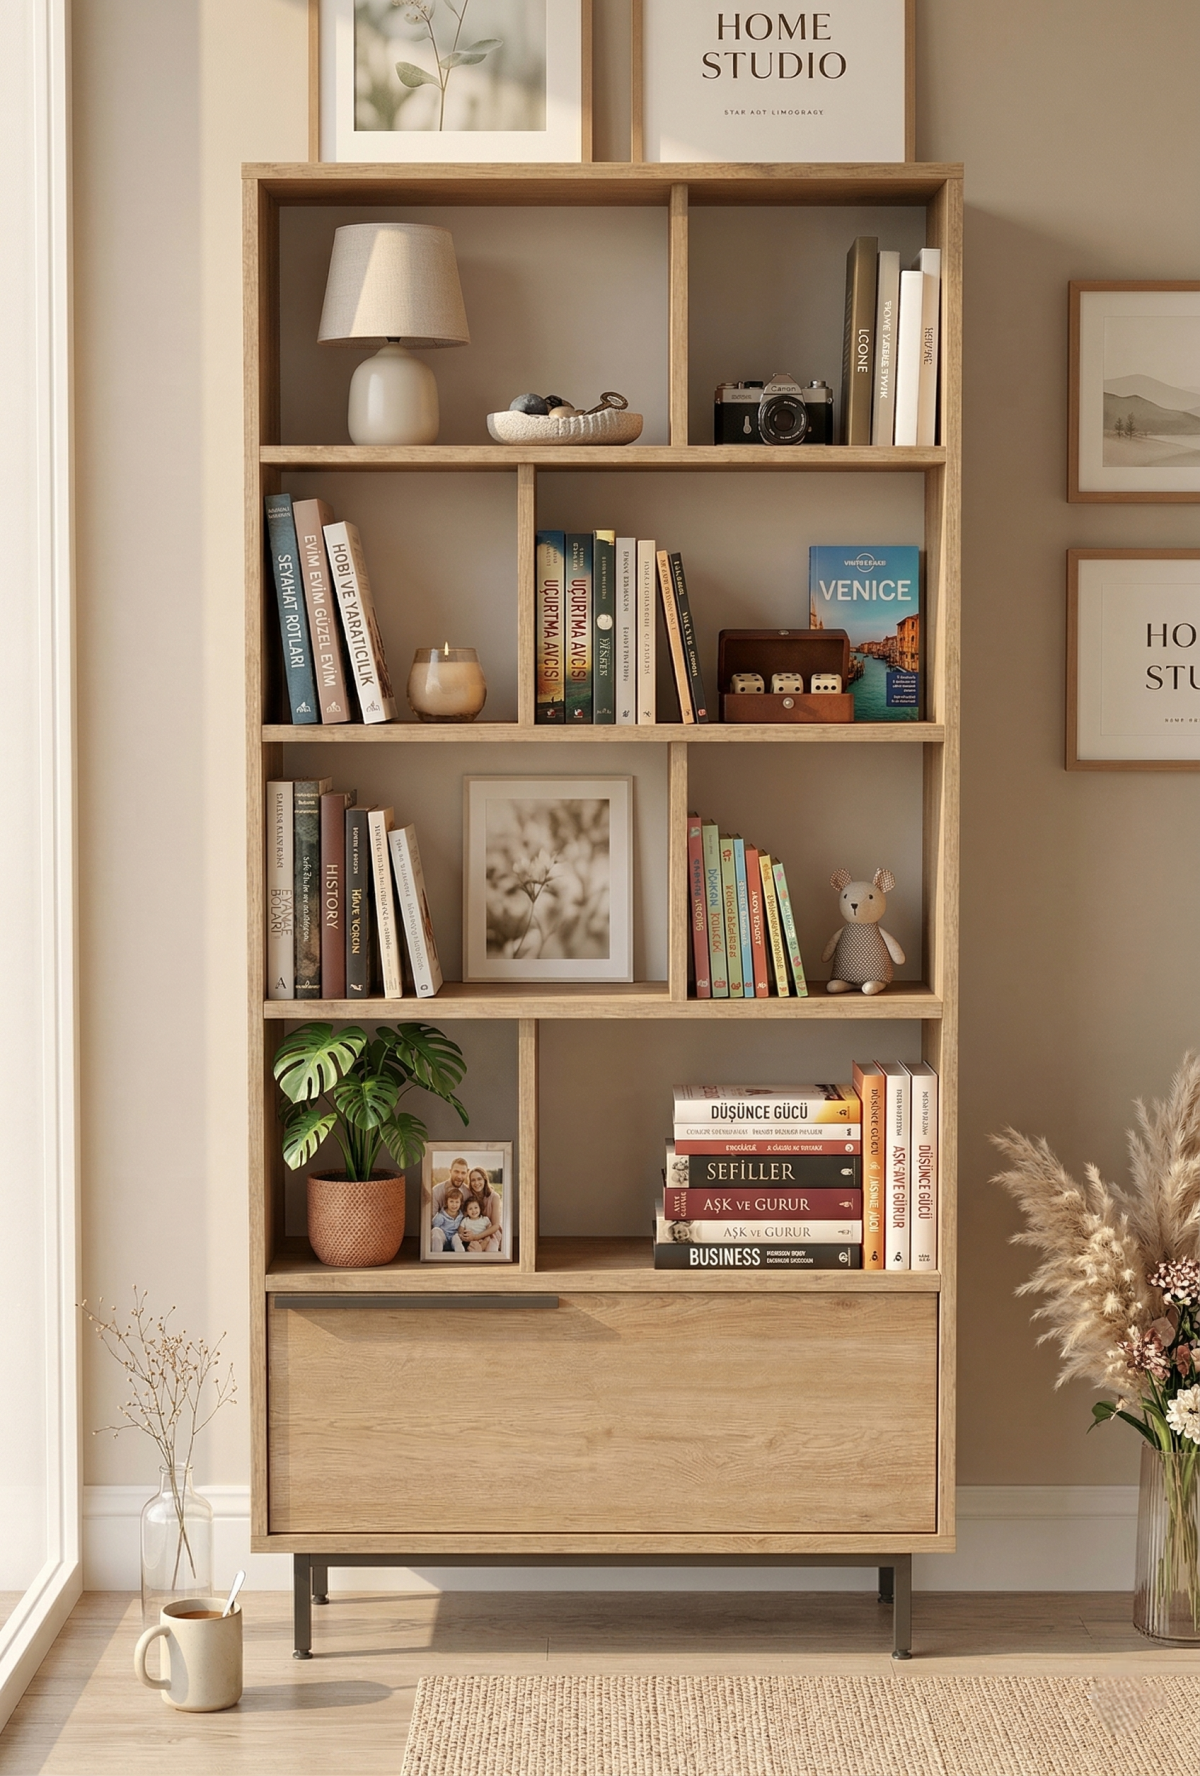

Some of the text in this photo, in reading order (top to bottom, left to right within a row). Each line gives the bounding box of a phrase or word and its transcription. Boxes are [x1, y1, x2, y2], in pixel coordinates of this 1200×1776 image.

[718, 13, 831, 40] HOME
[702, 52, 846, 79] STUDIO
[857, 329, 869, 373] LCONE
[540, 579, 559, 639] UÇURTMA
[567, 579, 586, 639] UÇURTMA
[819, 580, 912, 601] VENICE
[277, 554, 305, 668] SEYAHAT ROTLARI
[304, 535, 337, 687] EVİM EVİM GÜZEL EVİM
[332, 543, 374, 687] HOBİ VE YARATICILIK
[1147, 623, 1197, 648] HO
[543, 642, 559, 682] AVCISI
[571, 642, 586, 682] AVCISI
[326, 864, 338, 929] HISTORY
[711, 1103, 808, 1123] DÜŞÜNCE GÜCÜ
[706, 1160, 795, 1180] SEFİLLER
[916, 1145, 933, 1219] DÜŞÜNCE GÜCÜ
[704, 1198, 733, 1213] AŞK
[754, 1198, 810, 1211] GURUR
[893, 1193, 907, 1228] GÜRUR
[724, 1227, 747, 1240] AŞK
[764, 1227, 811, 1237] GURUR
[689, 1248, 760, 1266] BUSINESS
